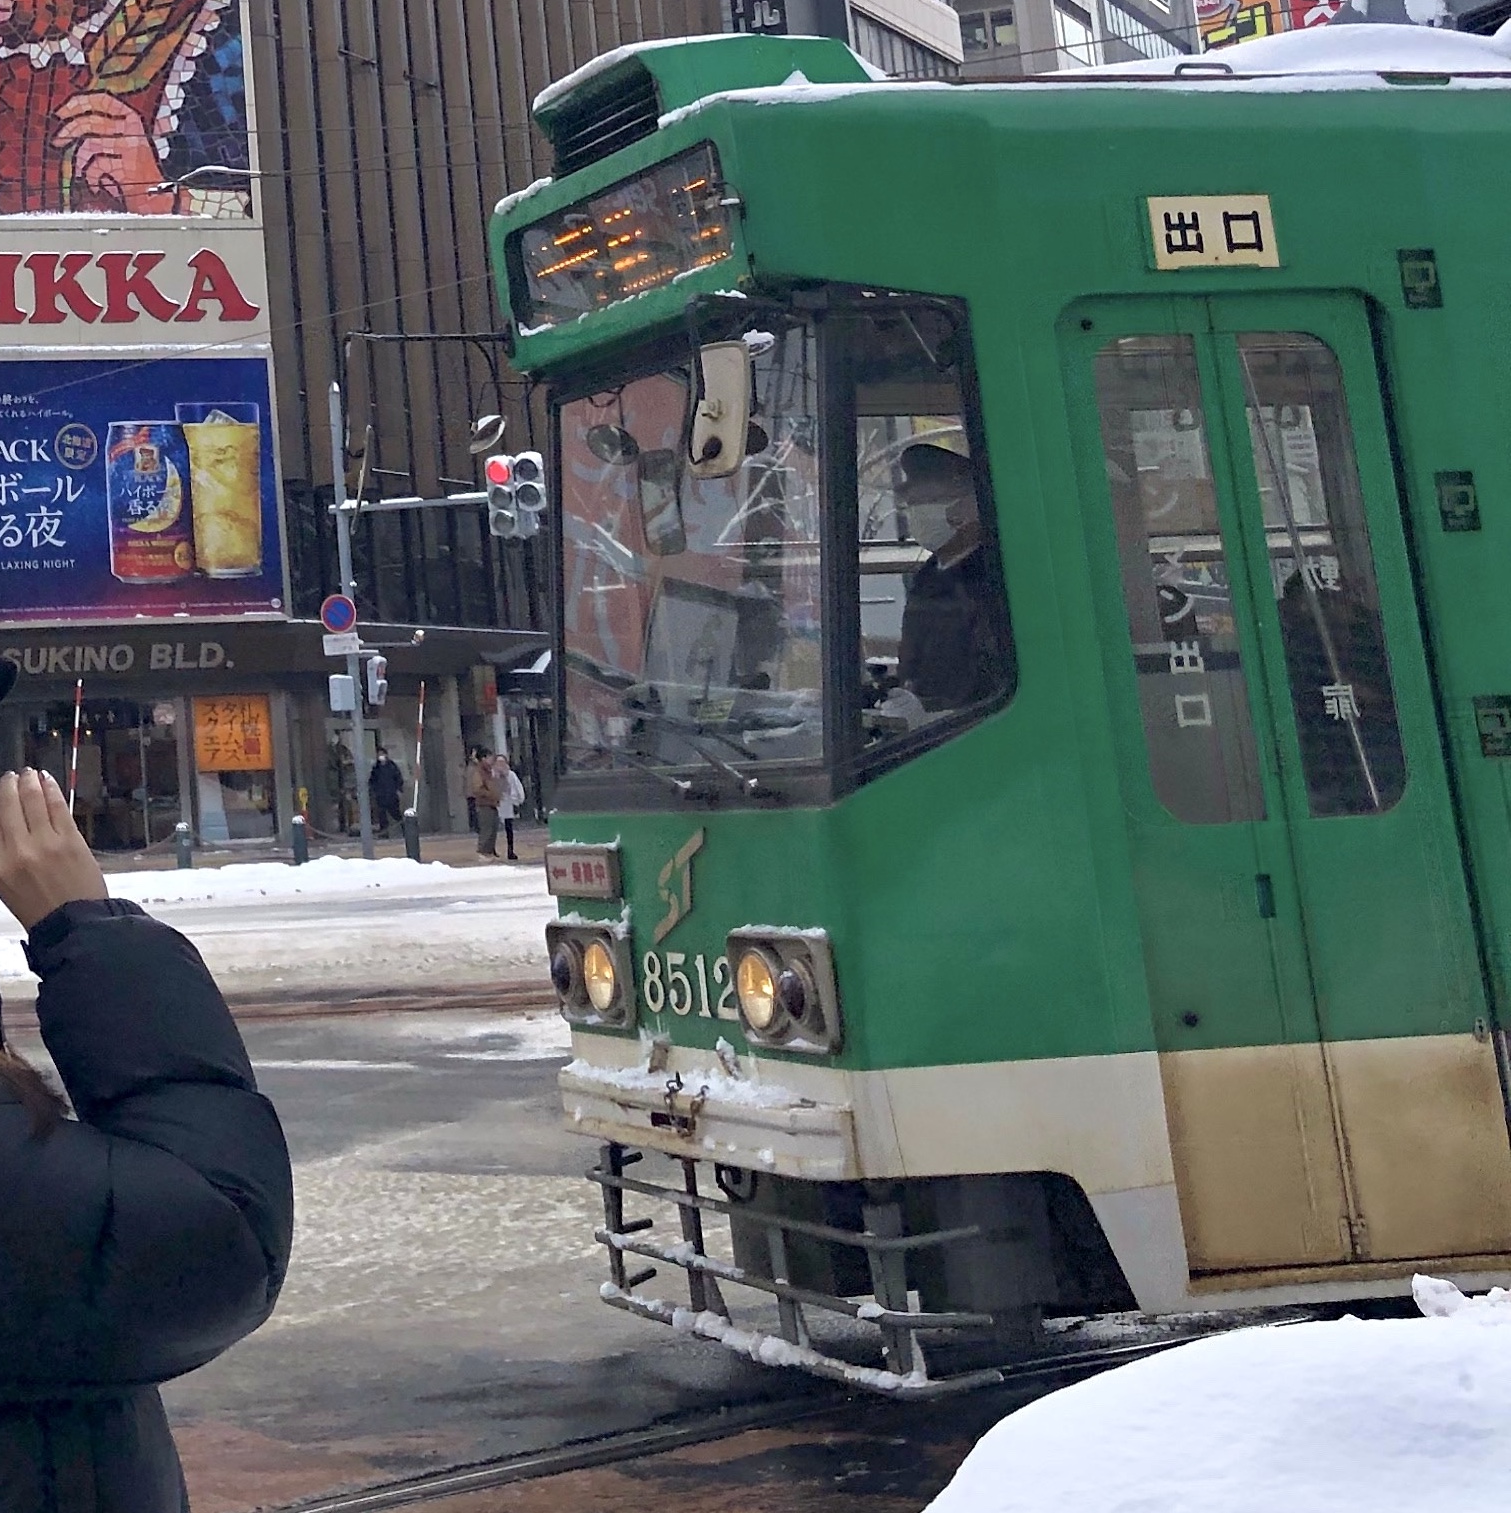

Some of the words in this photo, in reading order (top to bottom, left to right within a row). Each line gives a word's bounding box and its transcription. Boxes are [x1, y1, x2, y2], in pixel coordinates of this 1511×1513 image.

[1163, 210, 1264, 254] 出口
[120, 485, 169, 499] ハイボー
[43, 558, 76, 570] NIGHT
[149, 641, 235, 670] BLD.
[643, 950, 739, 1021] 8512
